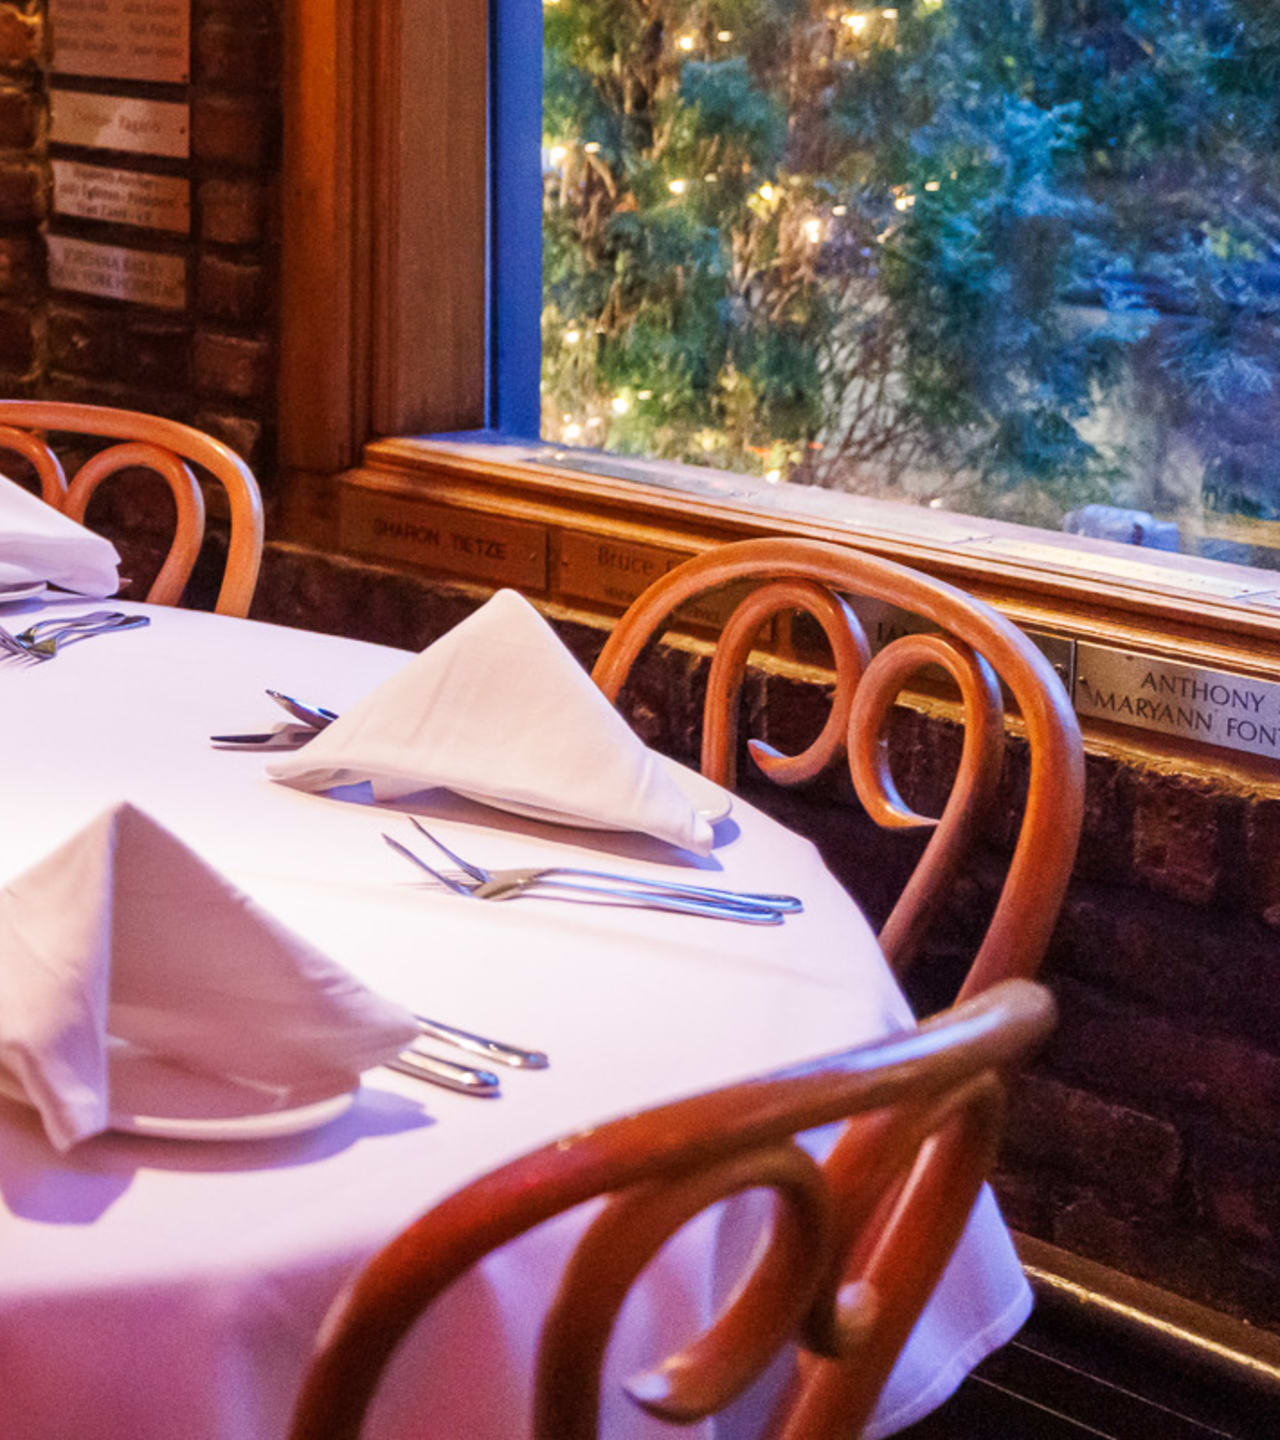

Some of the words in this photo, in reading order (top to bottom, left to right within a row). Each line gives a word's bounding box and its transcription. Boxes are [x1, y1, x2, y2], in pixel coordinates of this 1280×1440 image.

[598, 543, 654, 576] Bruce
[1095, 689, 1212, 732] MARYANN
[1141, 671, 1266, 712] ANTHONY
